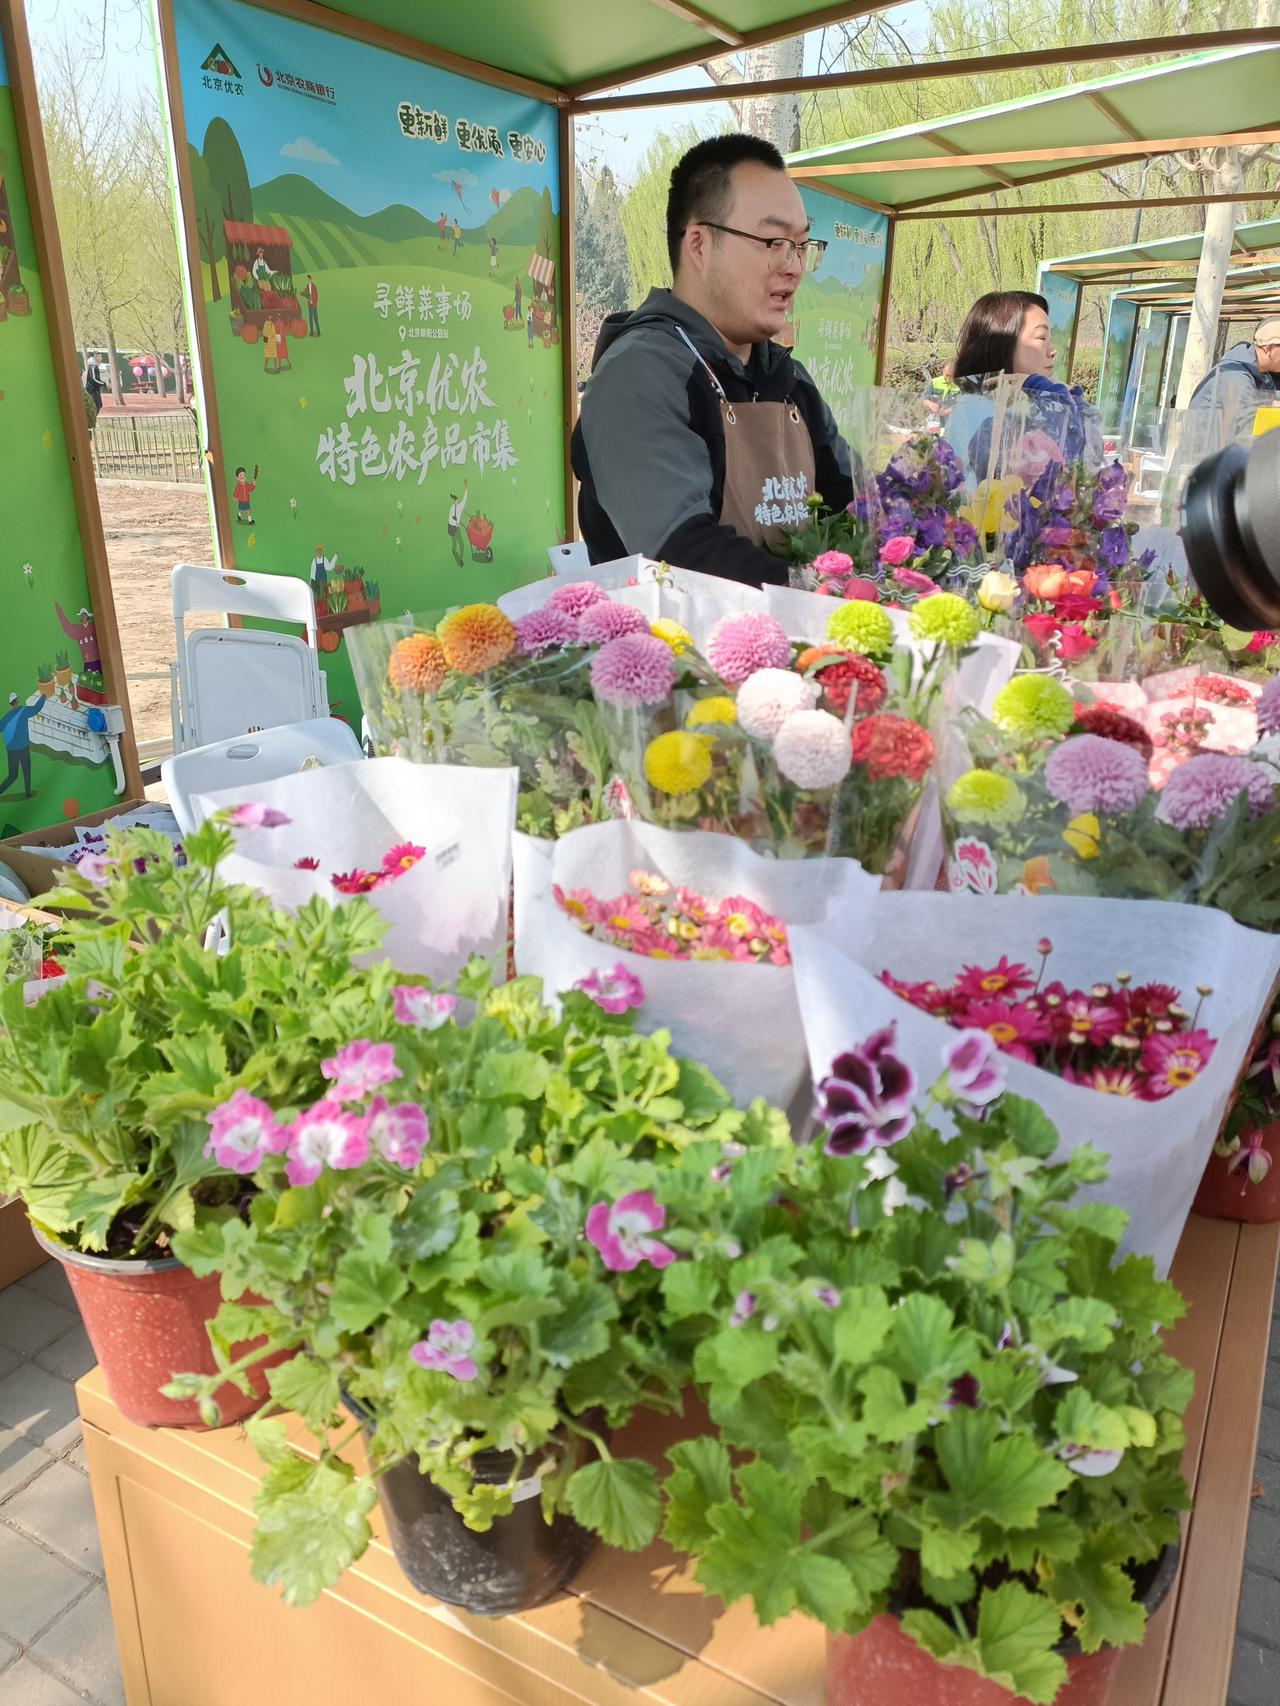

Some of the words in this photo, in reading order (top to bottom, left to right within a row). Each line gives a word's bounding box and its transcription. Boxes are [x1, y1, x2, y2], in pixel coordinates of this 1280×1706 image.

[201, 75, 244, 97] 北京优农
[275, 70, 335, 99] 北京农商银行
[398, 102, 448, 144] 更新鲜
[455, 118, 504, 158] 更优质
[507, 131, 546, 164] 更安心
[374, 282, 473, 324] 寻鲜菜事场
[343, 346, 498, 418] 北京优农
[316, 416, 519, 486] 特色农产品市集
